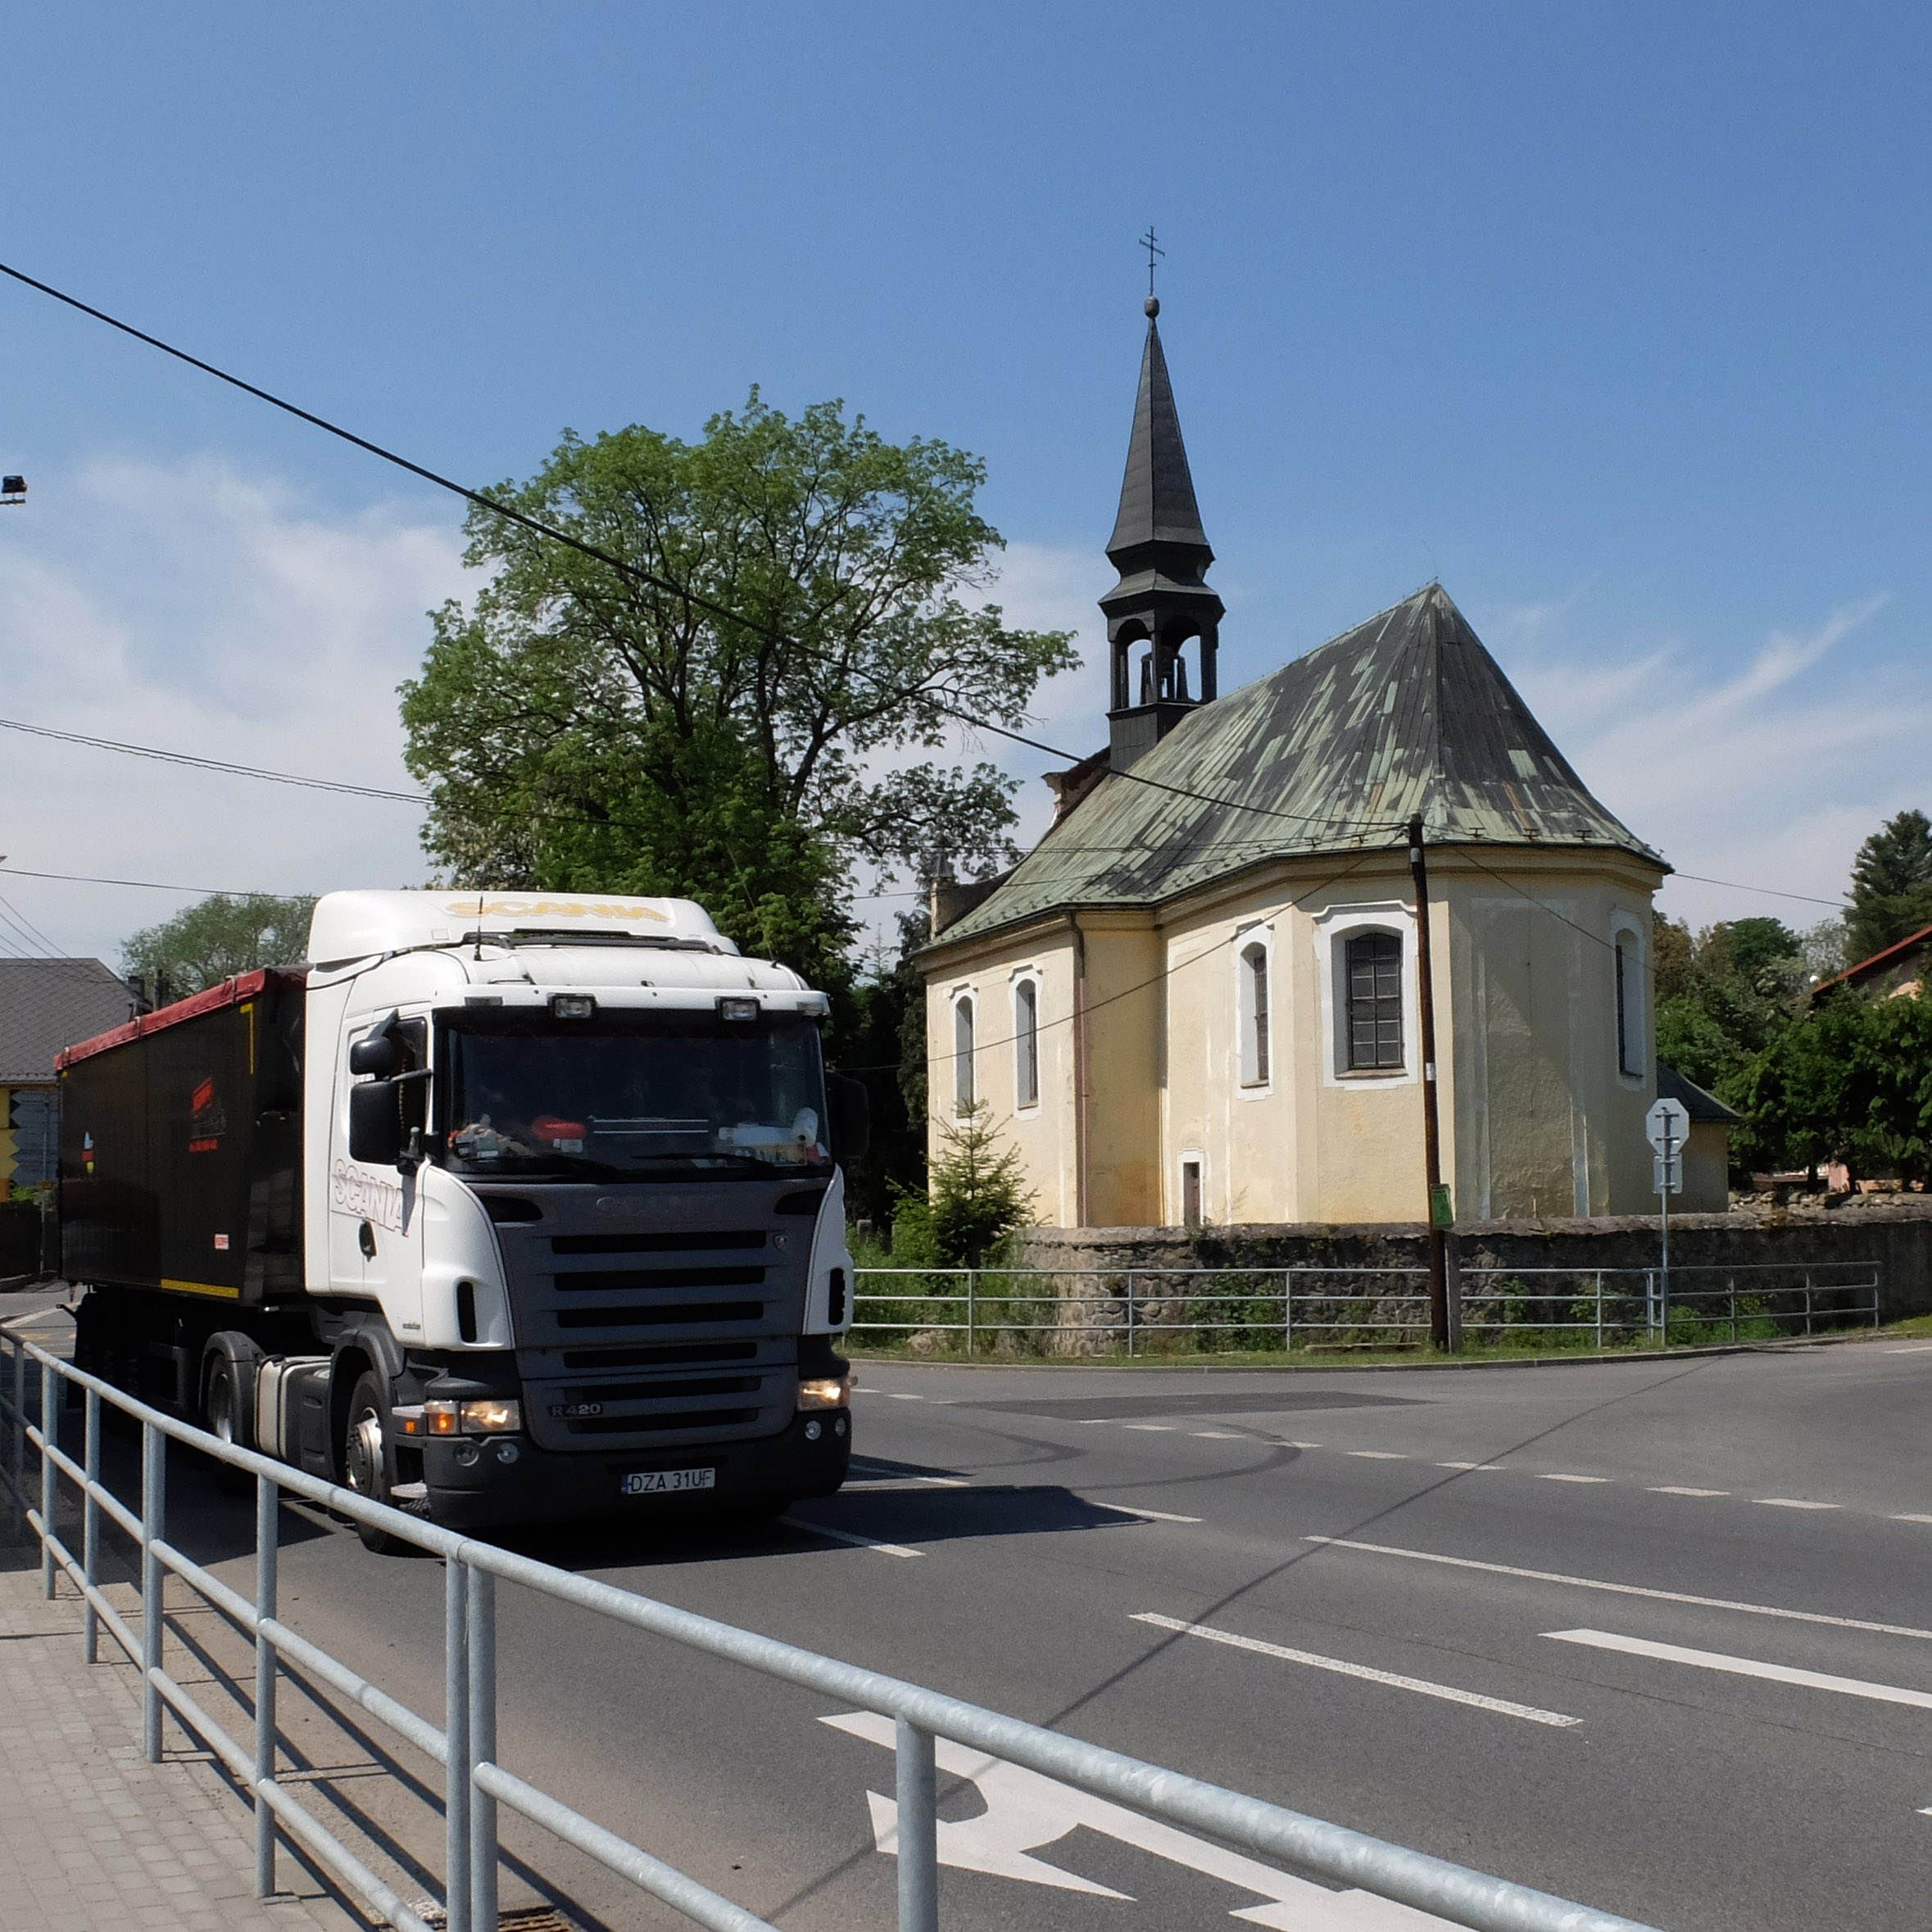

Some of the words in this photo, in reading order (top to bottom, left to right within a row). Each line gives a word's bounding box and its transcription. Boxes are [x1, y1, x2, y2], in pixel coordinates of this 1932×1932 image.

[446, 901, 672, 922] SCANIA
[334, 1159, 409, 1237] SCANIA
[552, 1406, 564, 1417] R
[565, 1404, 601, 1416] 420
[631, 1475, 666, 1492] DZA
[673, 1470, 713, 1488] 31UF
